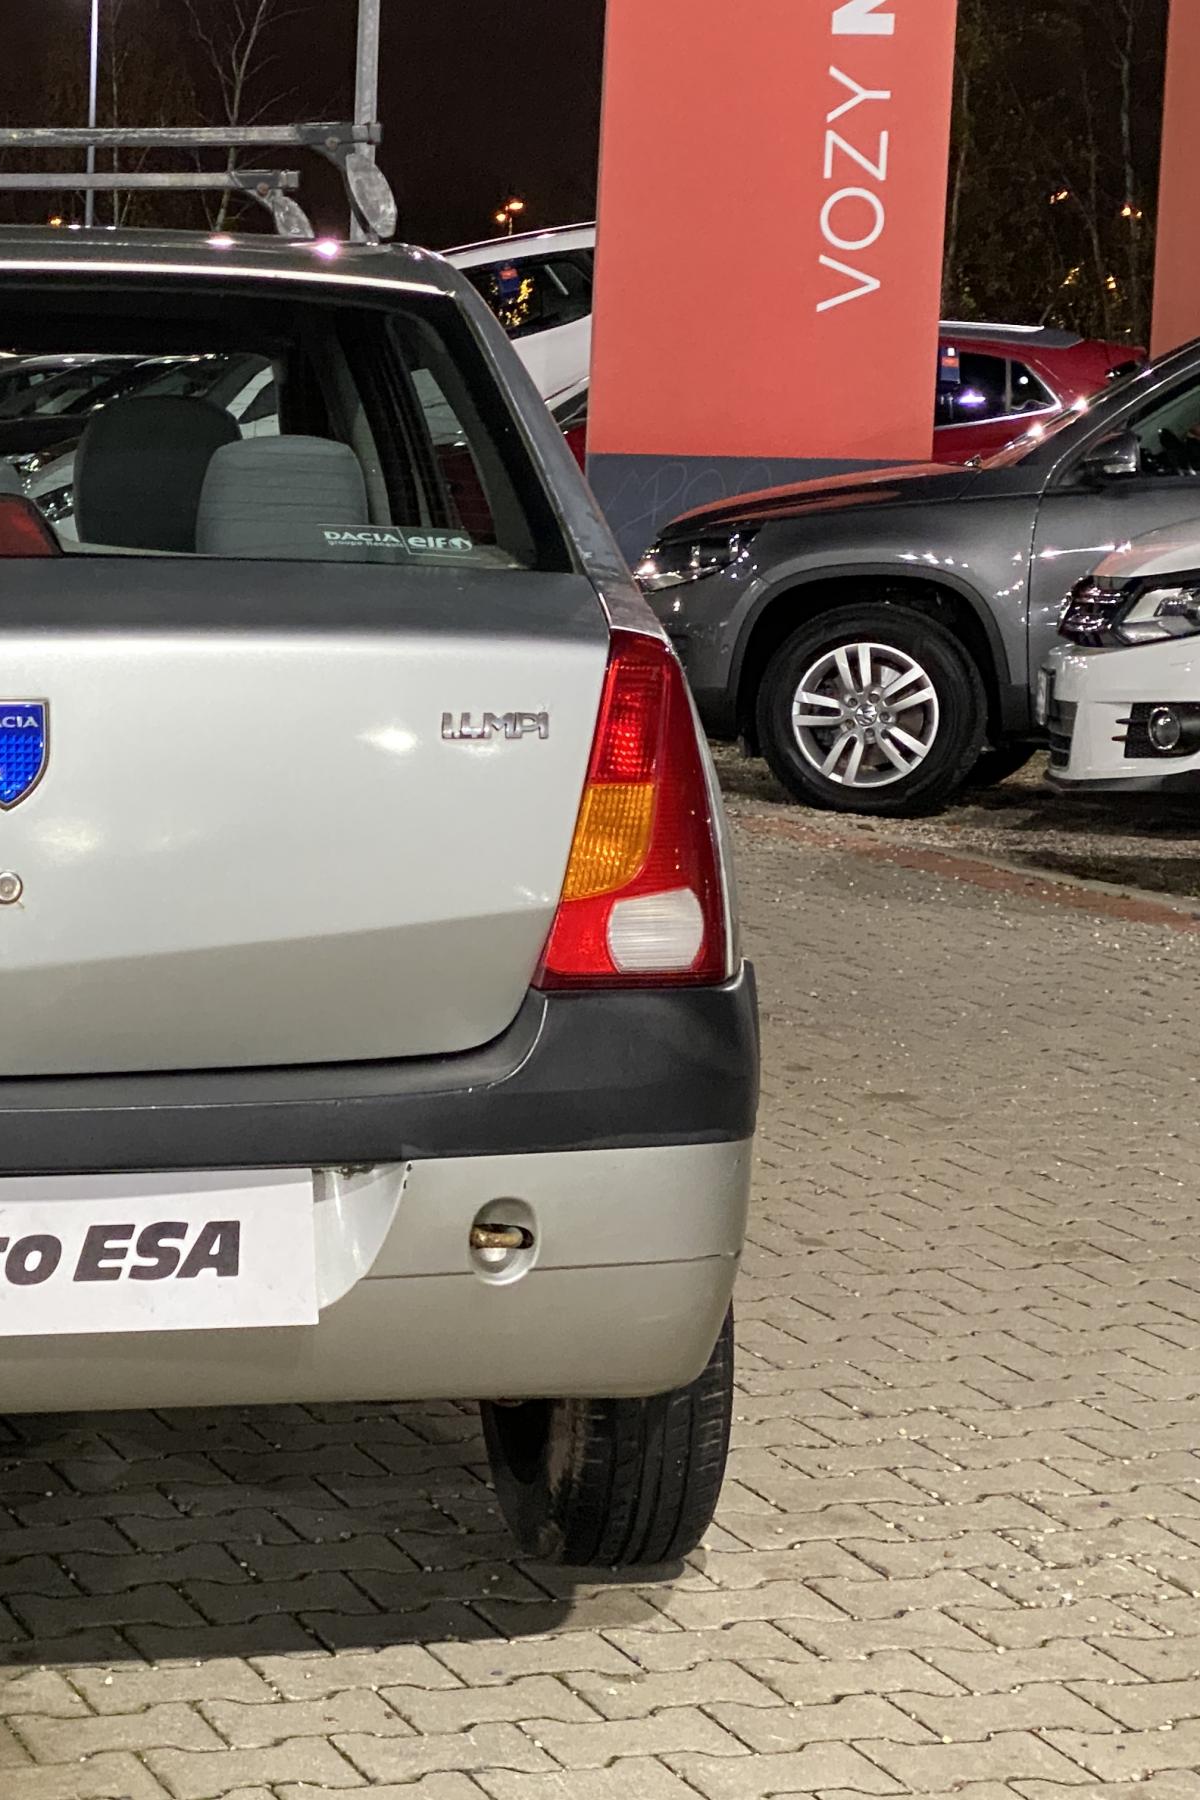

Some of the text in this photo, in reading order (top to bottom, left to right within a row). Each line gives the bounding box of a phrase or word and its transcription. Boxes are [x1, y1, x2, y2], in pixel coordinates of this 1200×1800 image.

[816, 65, 891, 312] VOZY
[323, 531, 400, 542] DACIA
[73, 1220, 241, 1282] ESA
